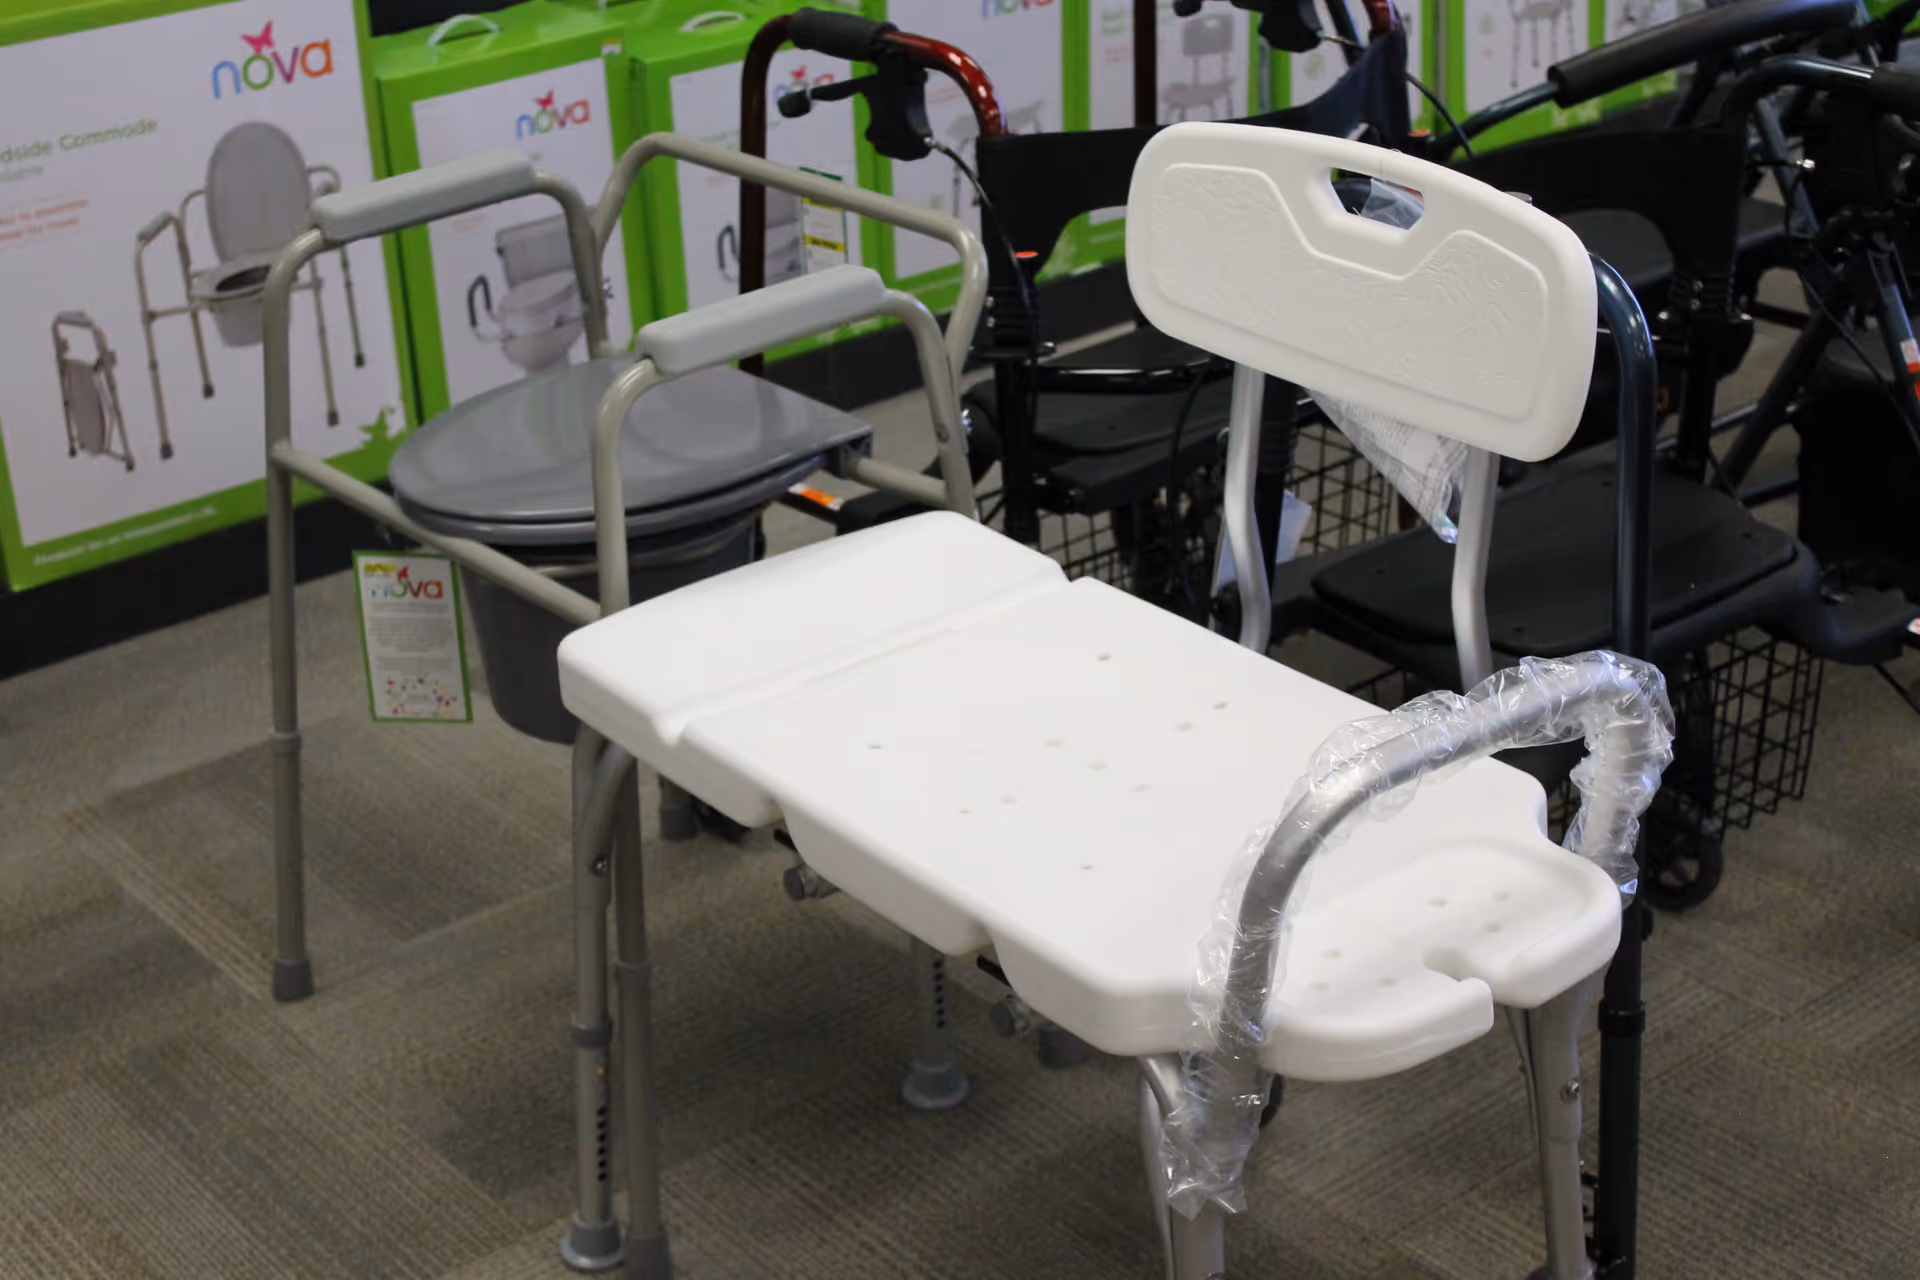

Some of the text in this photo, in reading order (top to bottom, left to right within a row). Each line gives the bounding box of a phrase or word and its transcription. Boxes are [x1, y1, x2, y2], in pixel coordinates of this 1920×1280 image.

[211, 38, 334, 99] nova
[59, 119, 157, 150] Commode
[516, 99, 590, 139] nova
